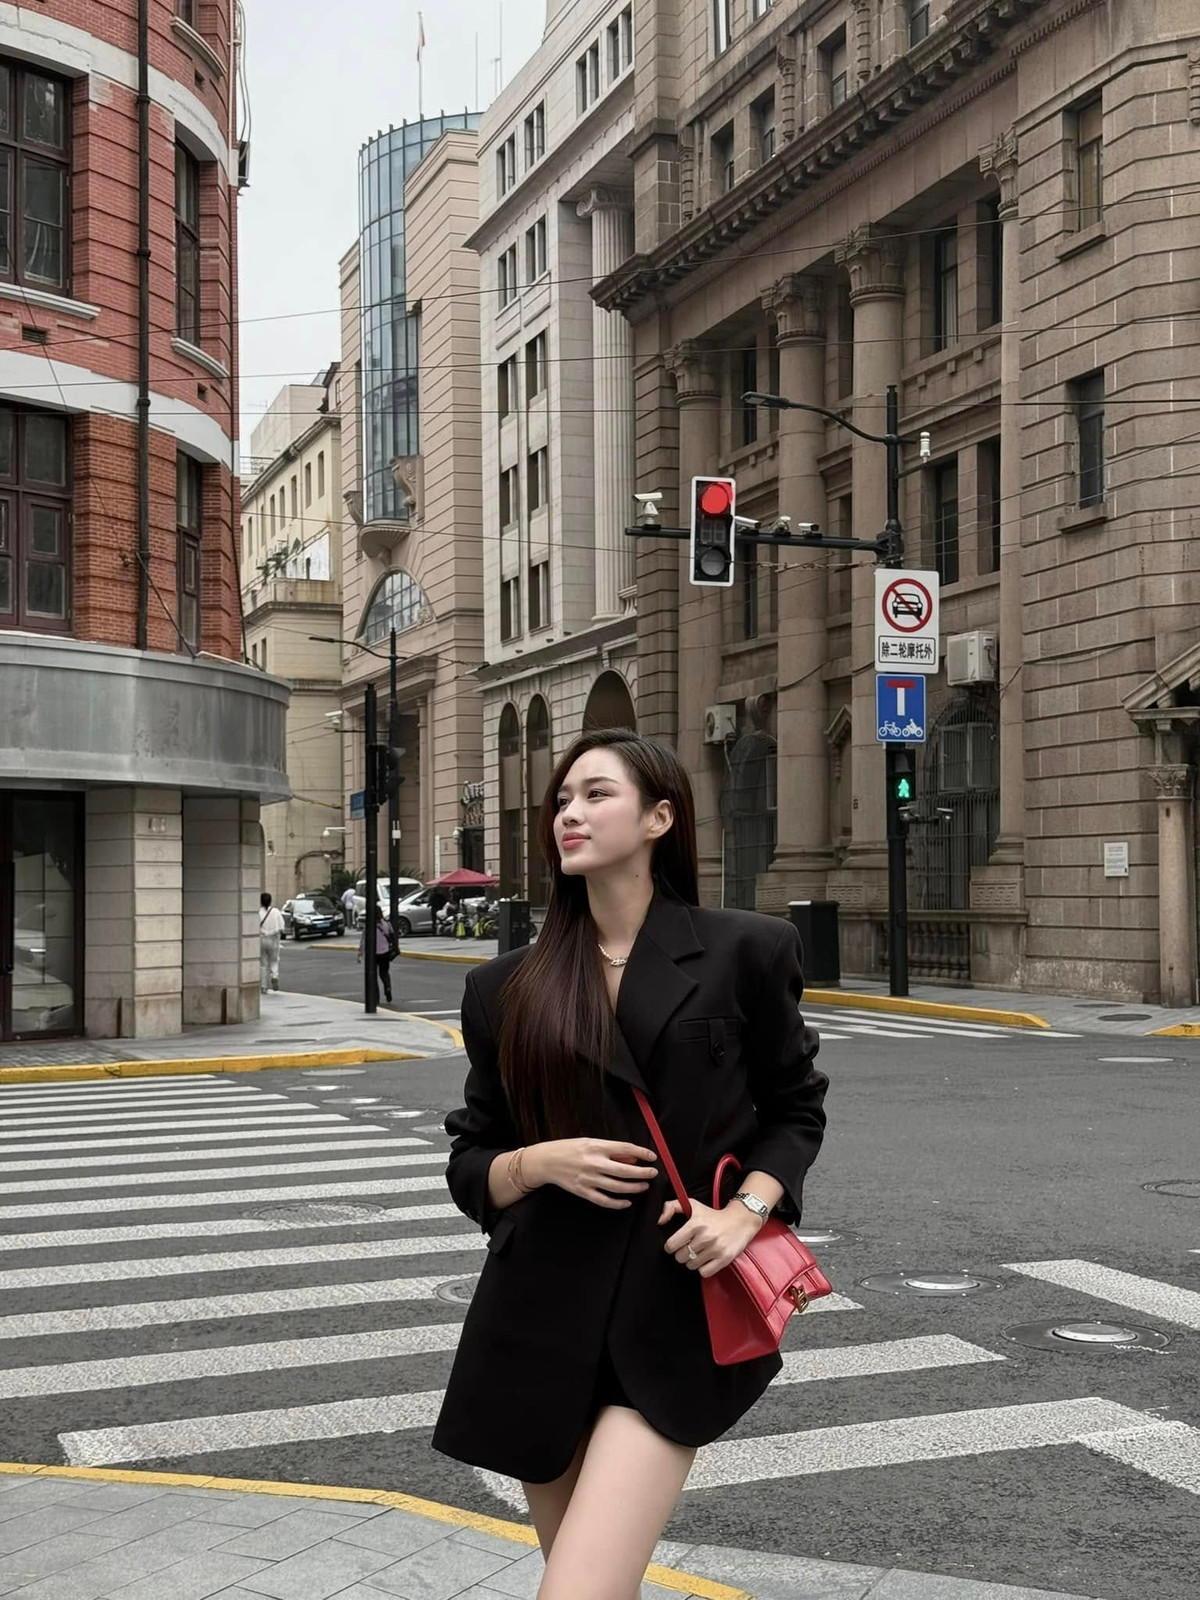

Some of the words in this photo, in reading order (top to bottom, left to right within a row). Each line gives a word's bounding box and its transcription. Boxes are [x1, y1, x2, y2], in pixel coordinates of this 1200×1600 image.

[881, 641, 932, 660] 除二轮摩托外
